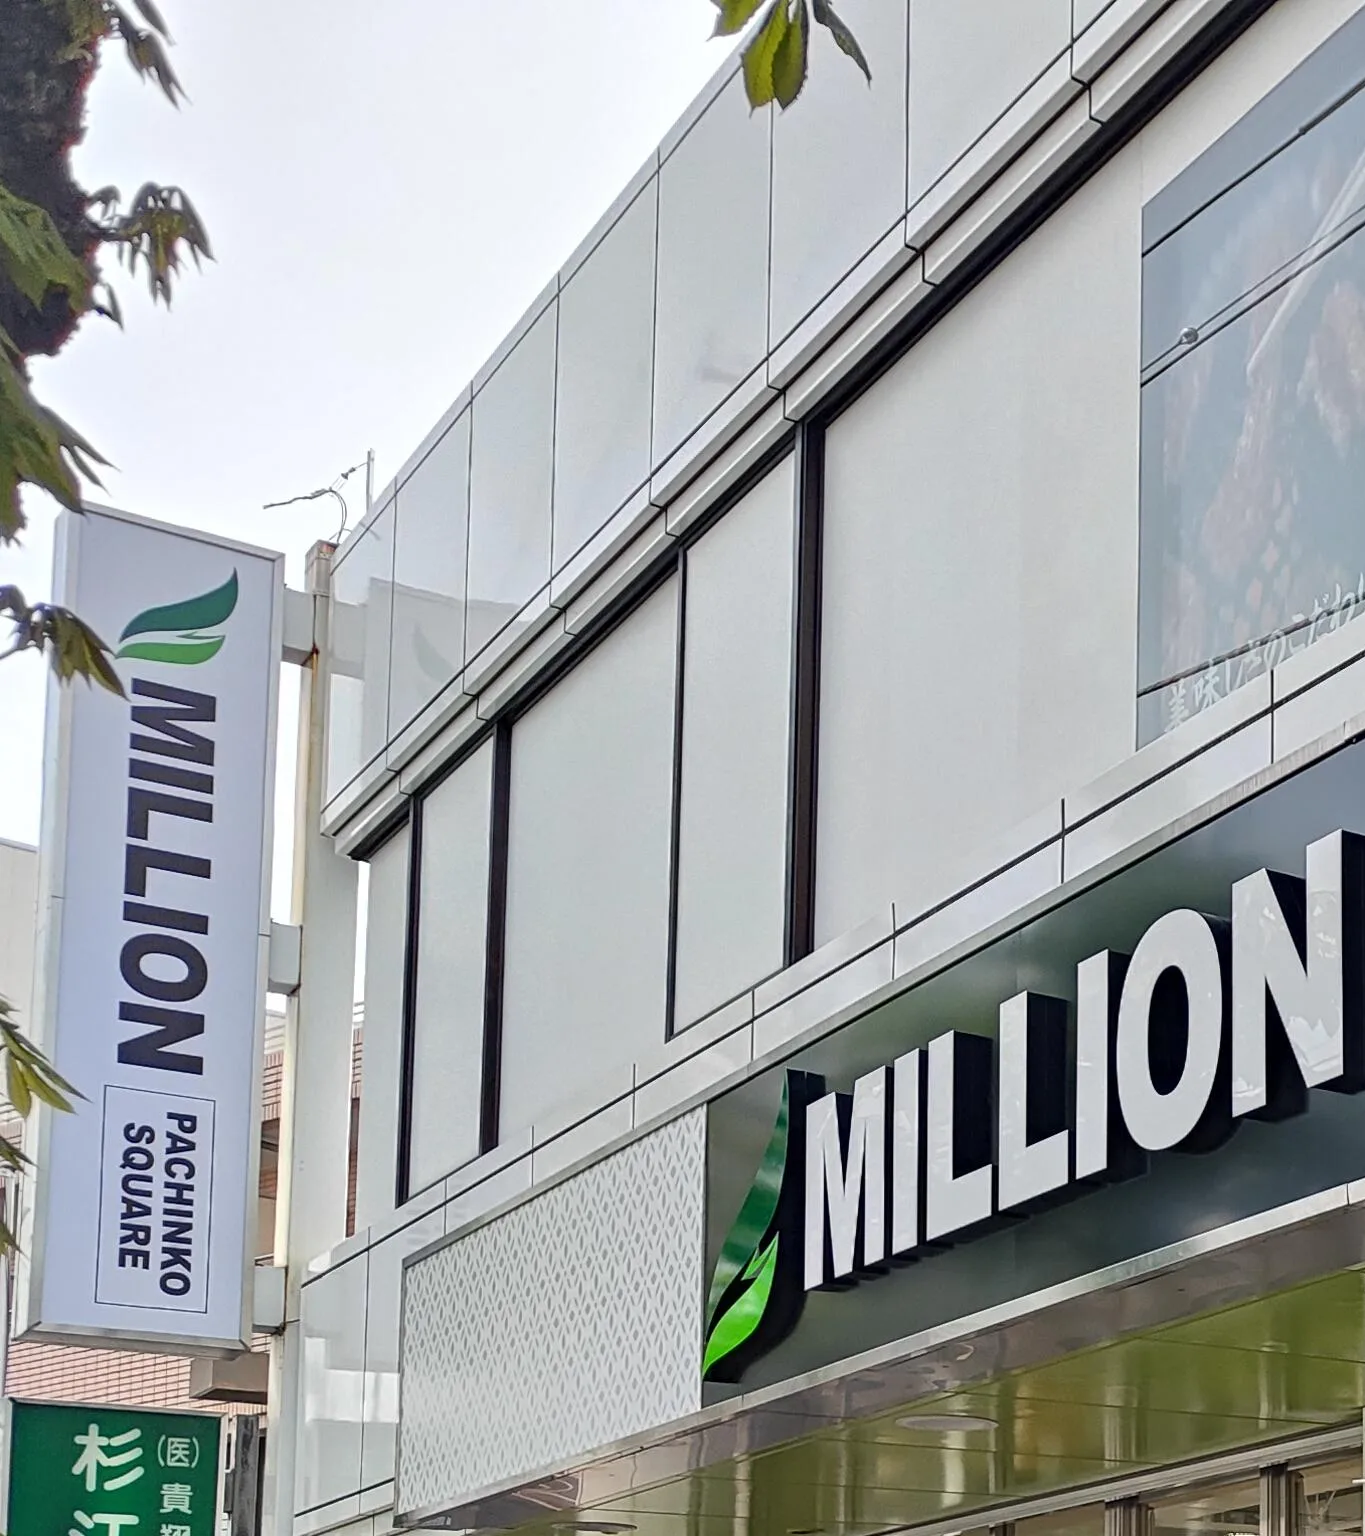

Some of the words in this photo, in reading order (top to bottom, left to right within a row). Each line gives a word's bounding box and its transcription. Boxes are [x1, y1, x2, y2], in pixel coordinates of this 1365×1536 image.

[117, 676, 217, 1075] MILLION
[118, 1122, 152, 1271] SQUARE
[158, 1111, 198, 1297] PACHINKO
[804, 828, 1365, 1292] MILLION
